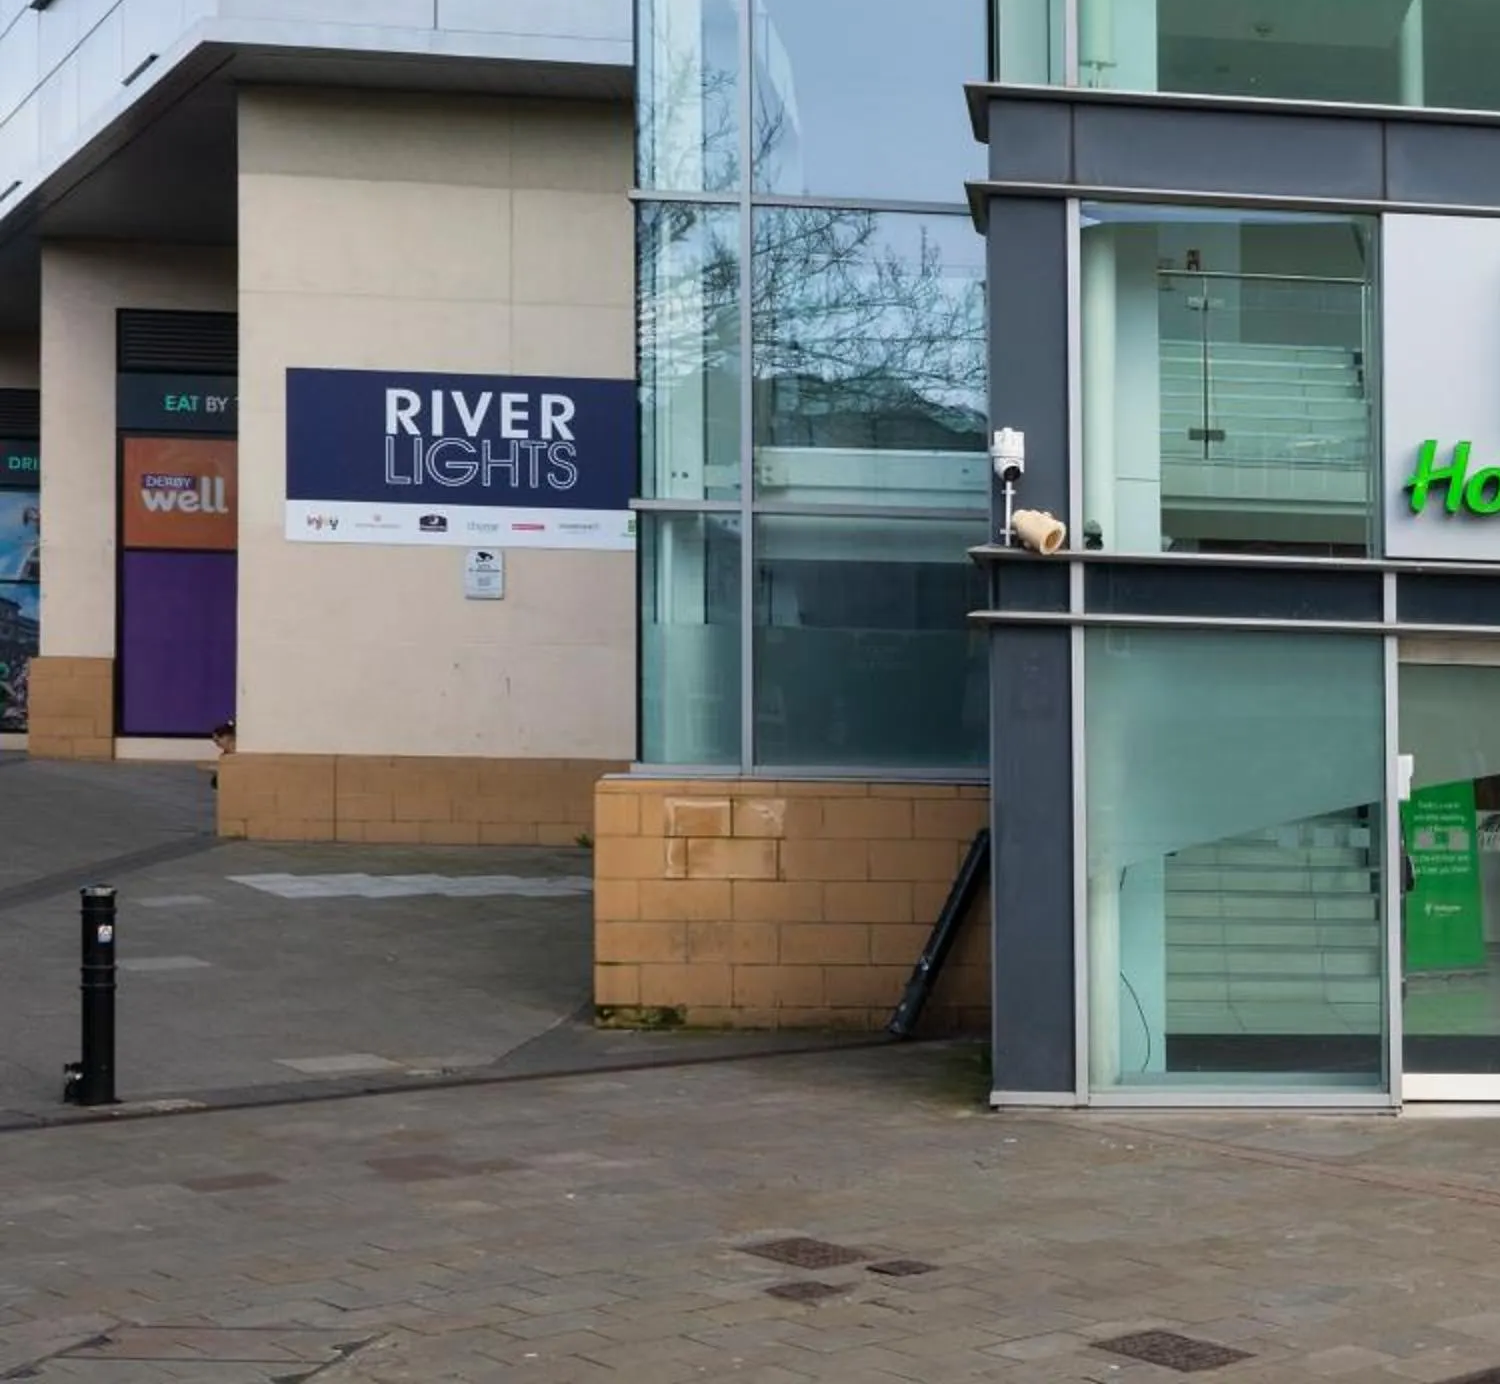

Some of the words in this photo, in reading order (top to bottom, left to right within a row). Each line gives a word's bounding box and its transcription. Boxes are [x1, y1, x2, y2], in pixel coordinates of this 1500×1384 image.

[164, 395, 199, 412] EAT
[205, 396, 229, 413] BY
[385, 387, 576, 440] RIVER
[385, 435, 578, 490] LIGHTS
[141, 476, 230, 513] well
[145, 475, 193, 488] DERBY
